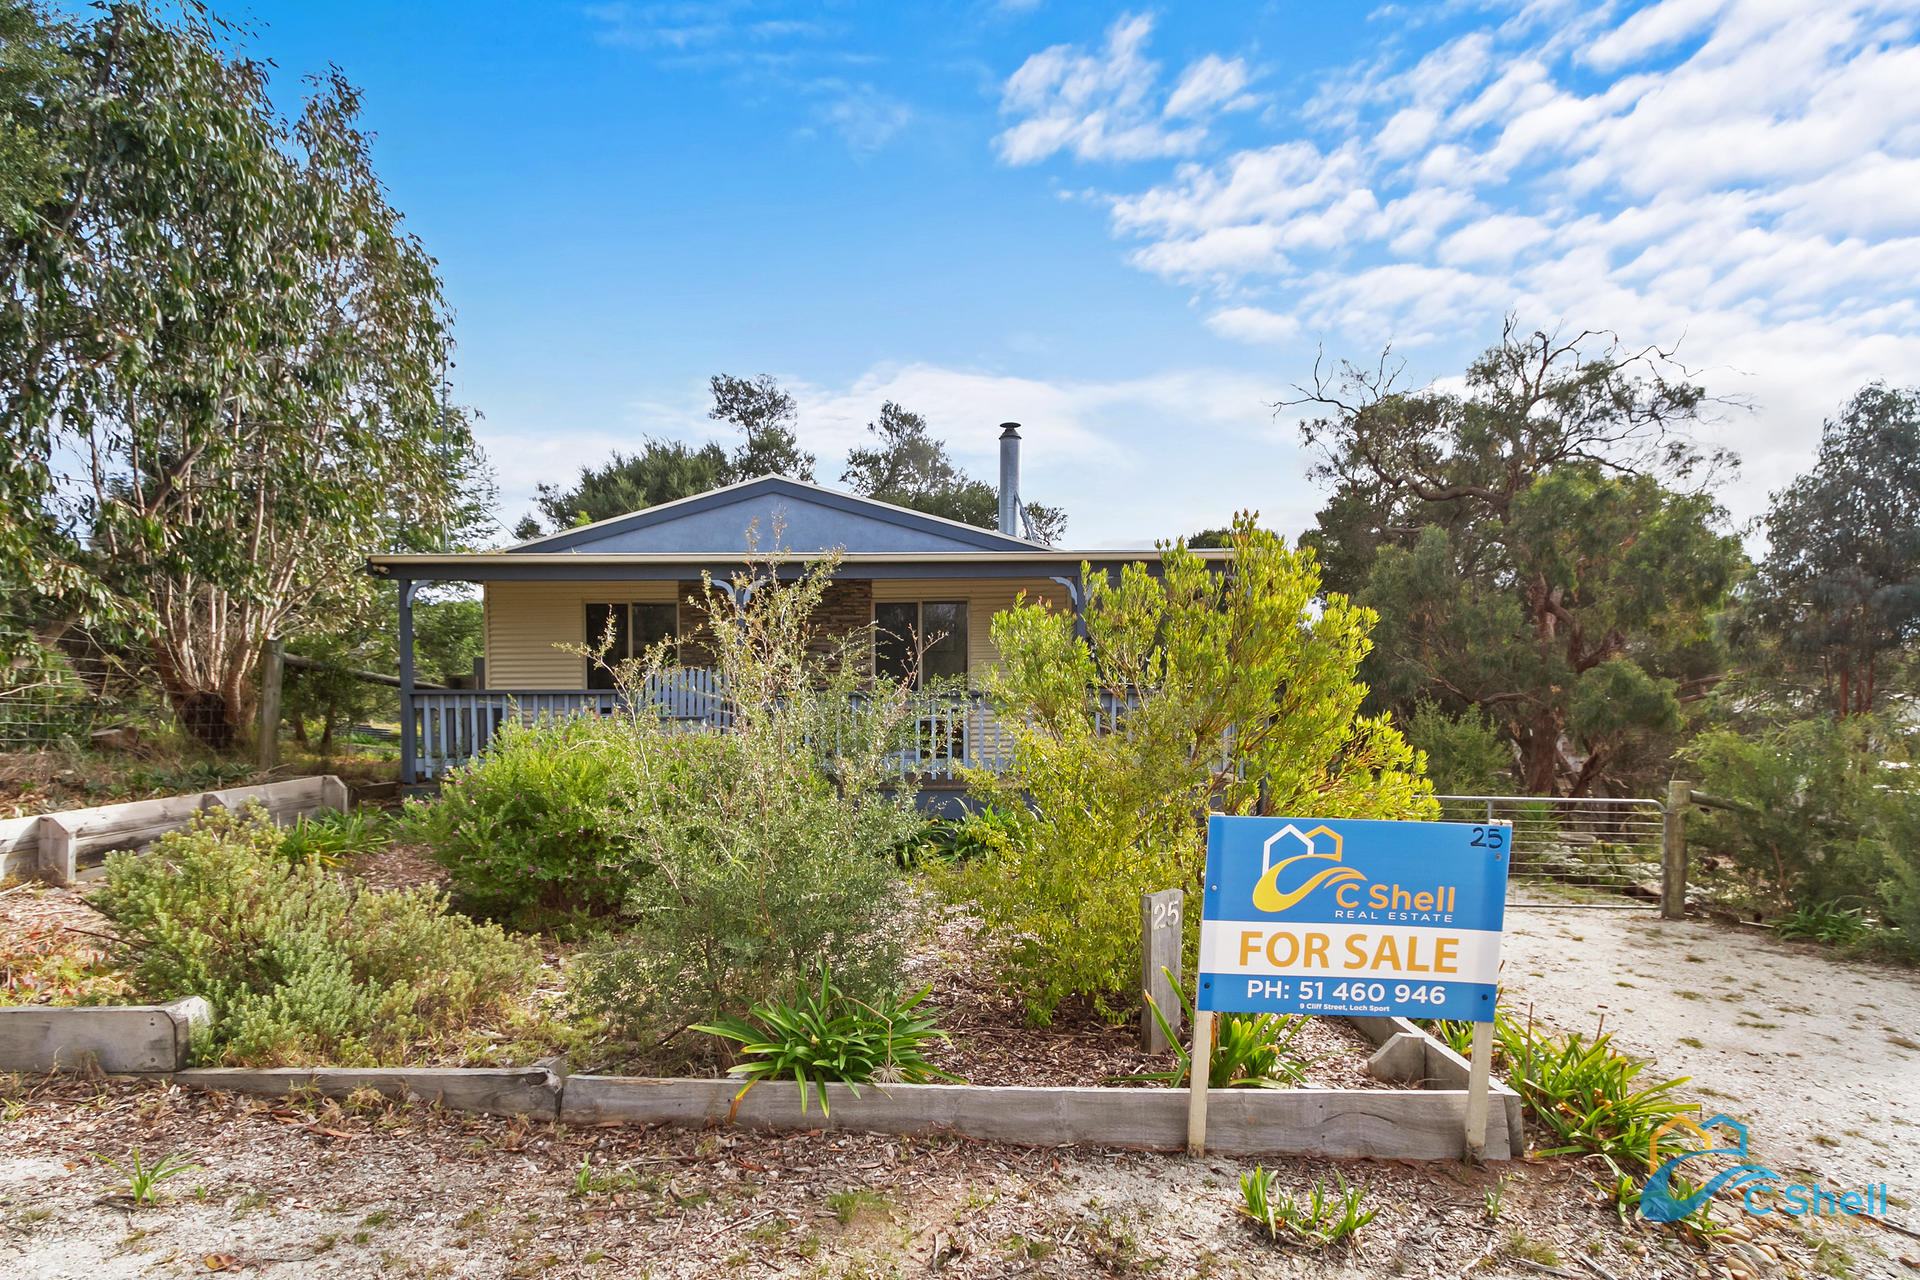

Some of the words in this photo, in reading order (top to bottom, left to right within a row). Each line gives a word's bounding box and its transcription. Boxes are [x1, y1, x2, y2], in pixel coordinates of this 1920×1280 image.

[1470, 827, 1503, 848] 25
[1336, 883, 1360, 908] C
[1368, 884, 1455, 912] Shell
[1153, 900, 1179, 930] 25
[1335, 910, 1378, 919] REAL
[1388, 912, 1453, 922] ESTATE
[1239, 931, 1330, 968] FOR
[1343, 933, 1459, 973] SALE
[1247, 980, 1290, 998] PH:
[1298, 981, 1323, 999] 51
[1332, 983, 1386, 1002] 460
[1394, 984, 1446, 1004] 946
[1323, 1003, 1347, 1011] Street,
